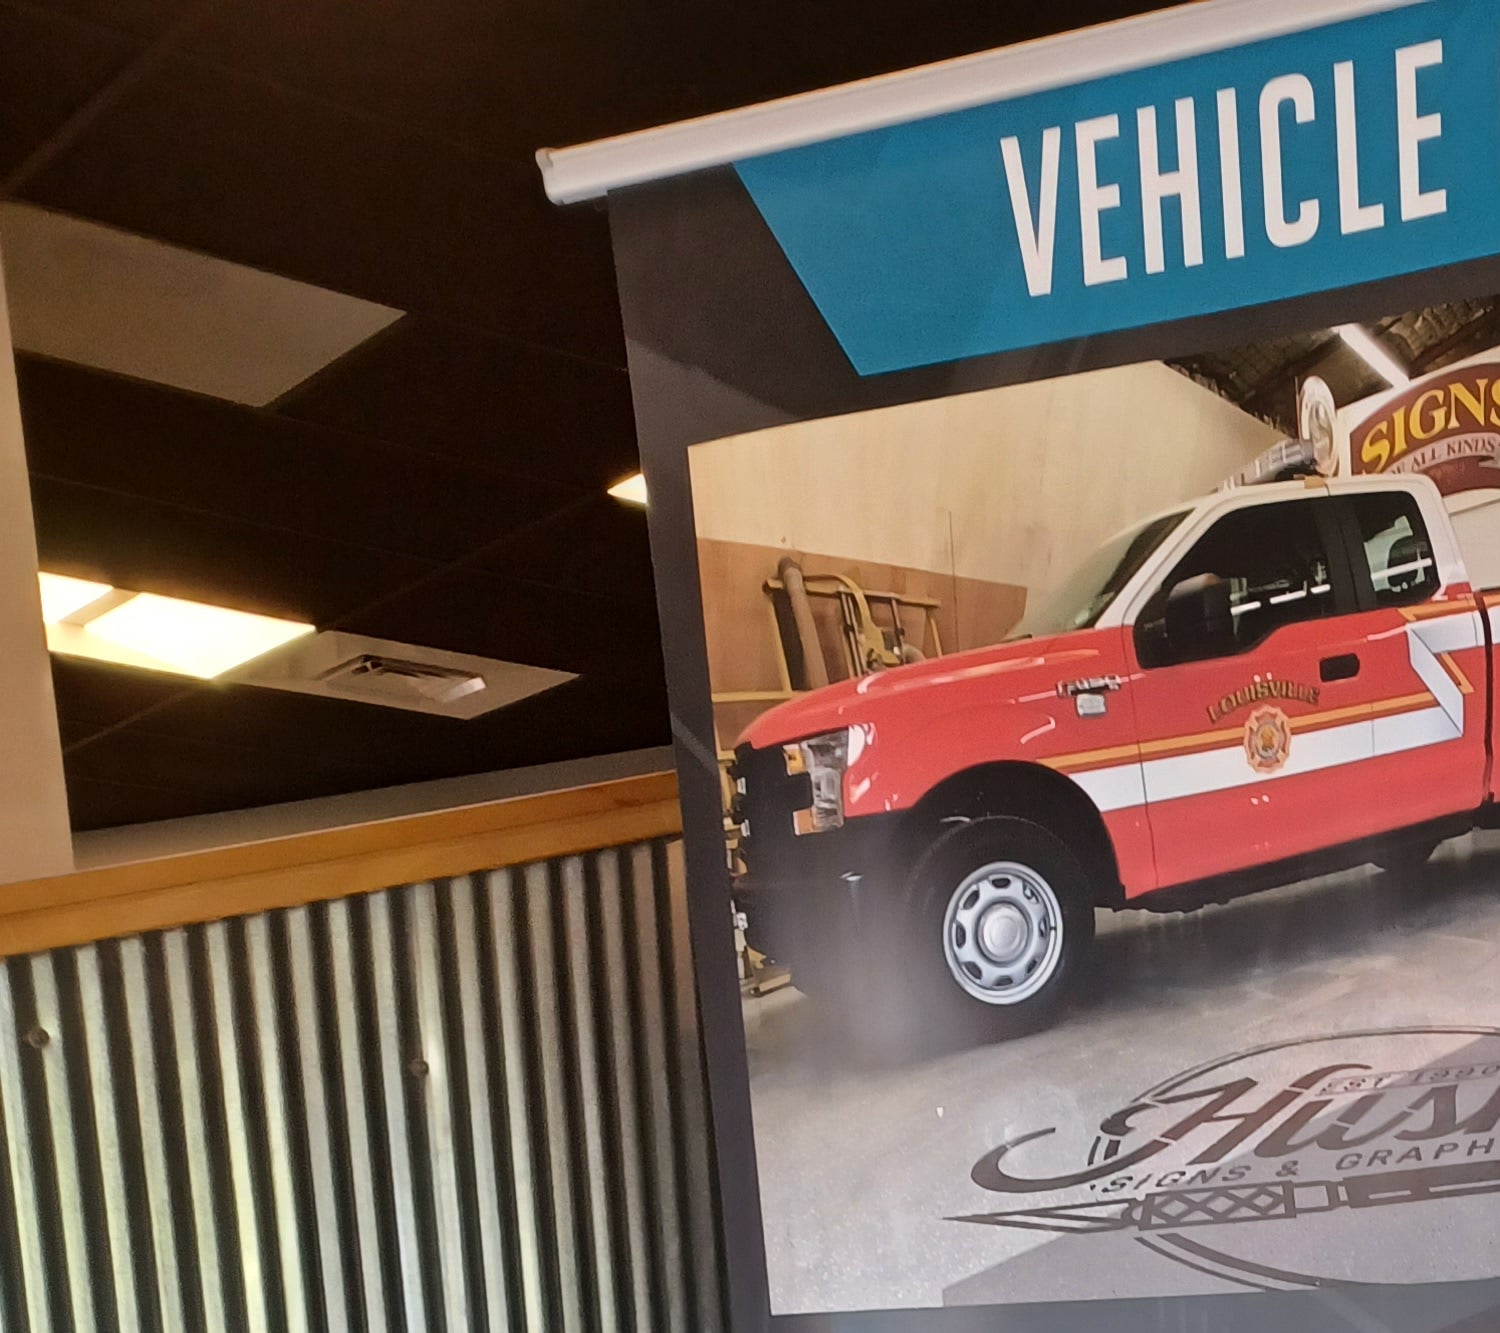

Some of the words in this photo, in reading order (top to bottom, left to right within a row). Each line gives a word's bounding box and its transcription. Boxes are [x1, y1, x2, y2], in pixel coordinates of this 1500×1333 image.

[1000, 40, 1447, 297] VEHICLE
[1447, 436, 1497, 456] KINDS
[1206, 681, 1320, 724] LOUISVILLE
[1101, 1166, 1252, 1193] SIGNS
[1275, 1160, 1299, 1177] &
